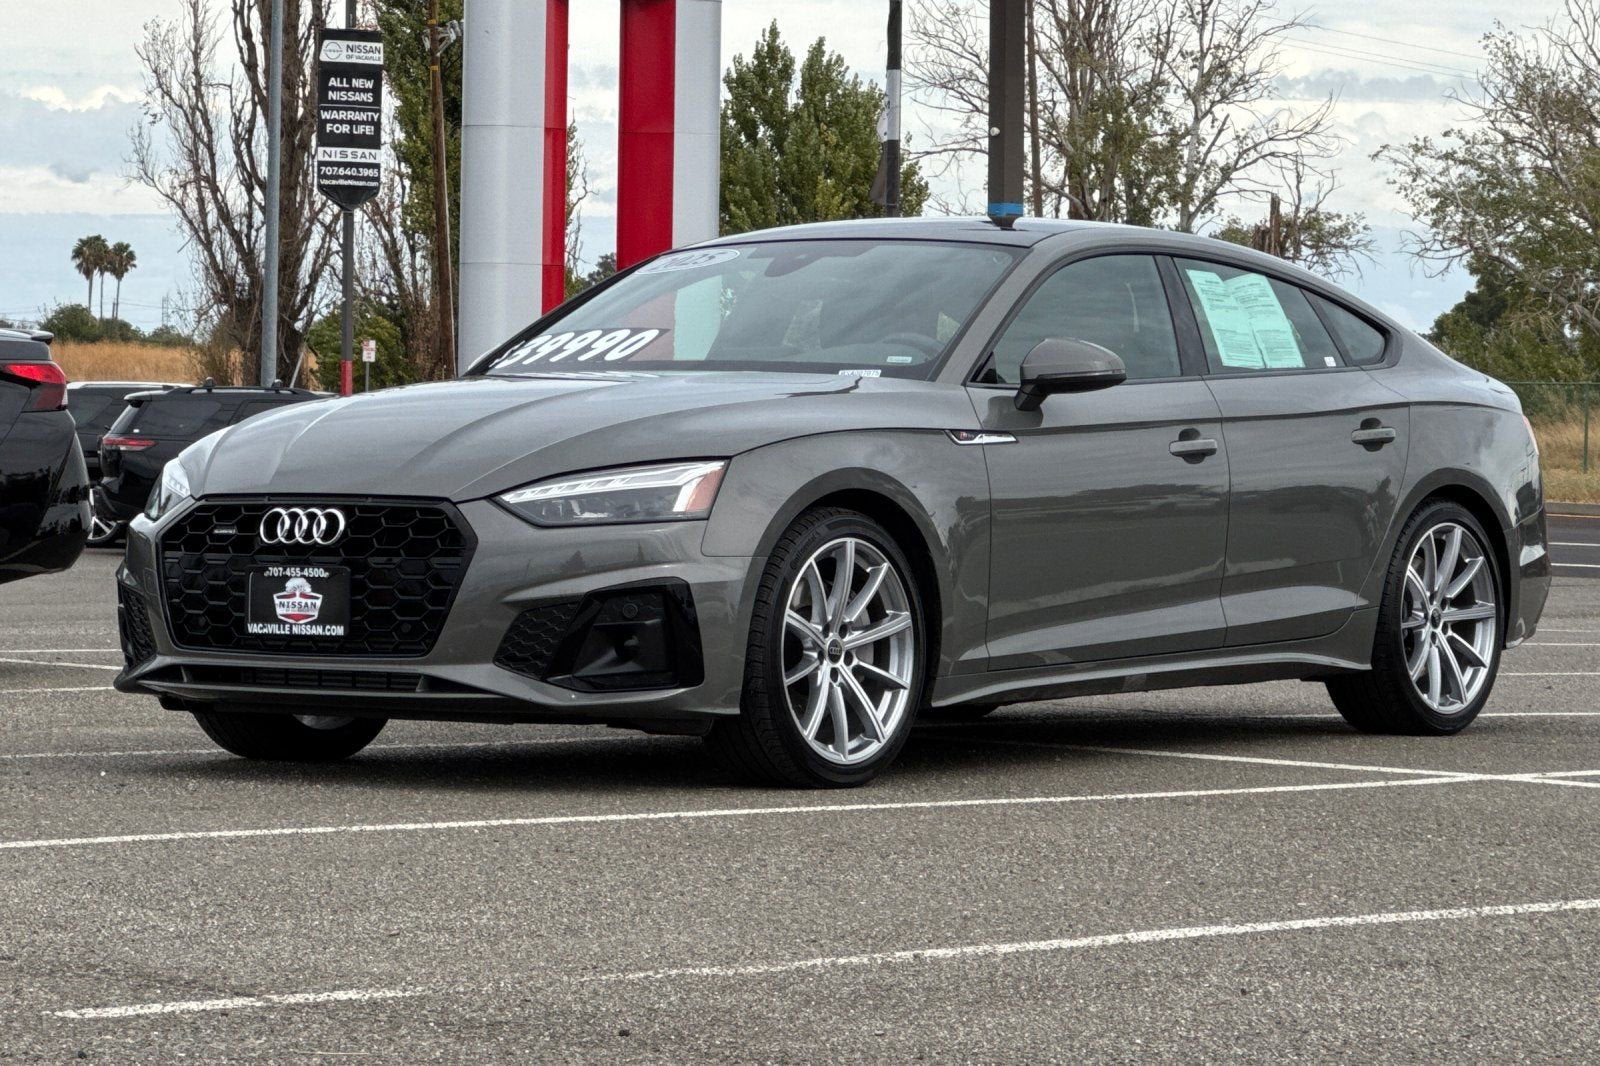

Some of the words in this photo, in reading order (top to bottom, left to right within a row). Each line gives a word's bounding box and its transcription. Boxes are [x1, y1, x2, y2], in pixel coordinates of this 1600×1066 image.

[346, 44, 381, 54] NISSAN
[328, 77, 350, 88] ALL
[352, 78, 374, 89] NEW
[328, 91, 373, 103] NISSANS
[320, 110, 379, 122] WARRANTY
[326, 123, 351, 134] FOR
[353, 125, 375, 136] LIFE!
[322, 150, 377, 161] NISSAN
[320, 166, 379, 178] 707.640.3965
[268, 567, 325, 578] 707-455-4500
[279, 601, 317, 609] NISSAN
[247, 623, 291, 634] VACAVILLE
[292, 624, 345, 636] NISSAN.COM
